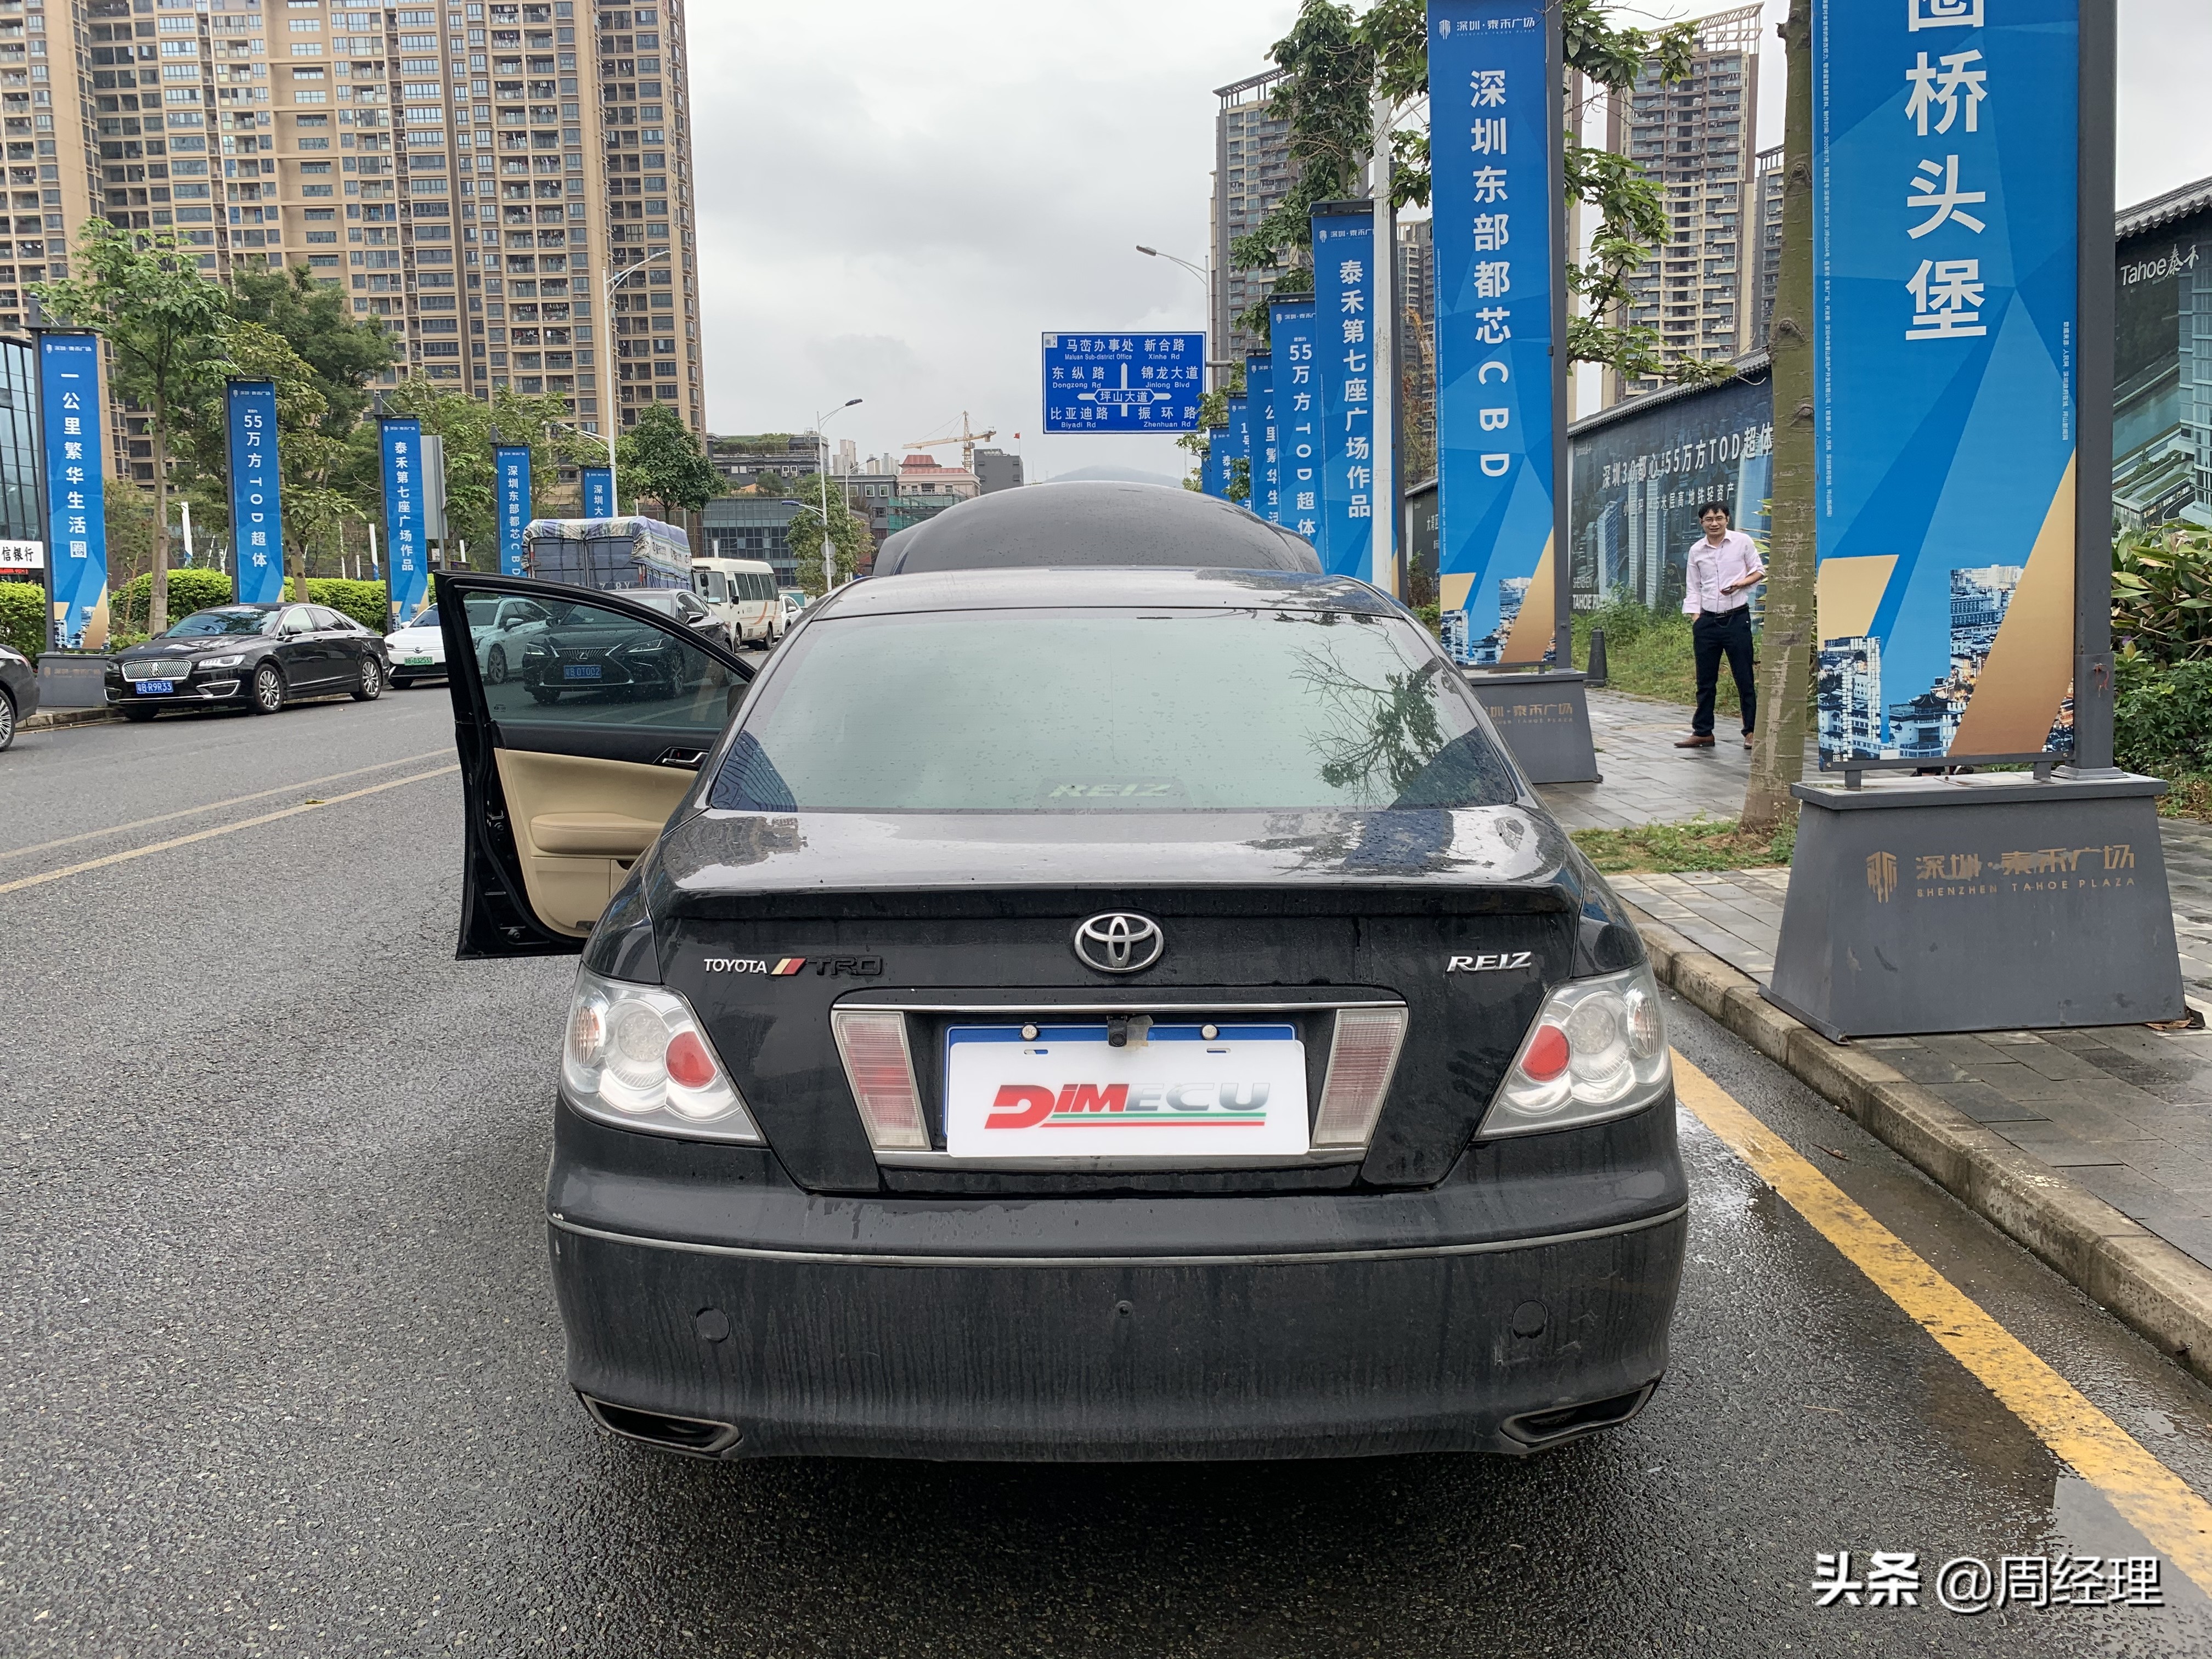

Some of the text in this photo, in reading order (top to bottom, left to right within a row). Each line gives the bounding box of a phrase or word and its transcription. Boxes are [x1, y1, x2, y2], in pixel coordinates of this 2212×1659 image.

[1330, 229, 1374, 238] 深圳·泰禾广
[1470, 70, 1511, 477] 深圳东部都芯CBD
[1066, 338, 1185, 352] 马峦办事处 新合路
[1052, 366, 1105, 380] 东纵路
[1141, 366, 1198, 380] 锦龙大道
[1100, 391, 1148, 402] 坪山大道
[1339, 259, 1371, 518] 泰禾第七座广场作品
[1051, 407, 1108, 420] 比亚迪路
[1138, 407, 1197, 420] 振环路
[60, 373, 87, 558] 一公里繁华生活圈
[244, 415, 267, 567] 55万方TOD超体
[594, 484, 603, 518] 深圳大
[394, 441, 414, 571] 泰禾第七座广场作品
[507, 465, 521, 575] 深圳东部都芯CBD
[1, 546, 33, 562] 信银行
[1485, 703, 1573, 718] 圳·泰禾广场
[1917, 878, 2135, 898] SHENZHEN TAHOE PLAZA
[704, 955, 883, 975] TOYOTA TRD
[1446, 951, 1532, 973] REIZ
